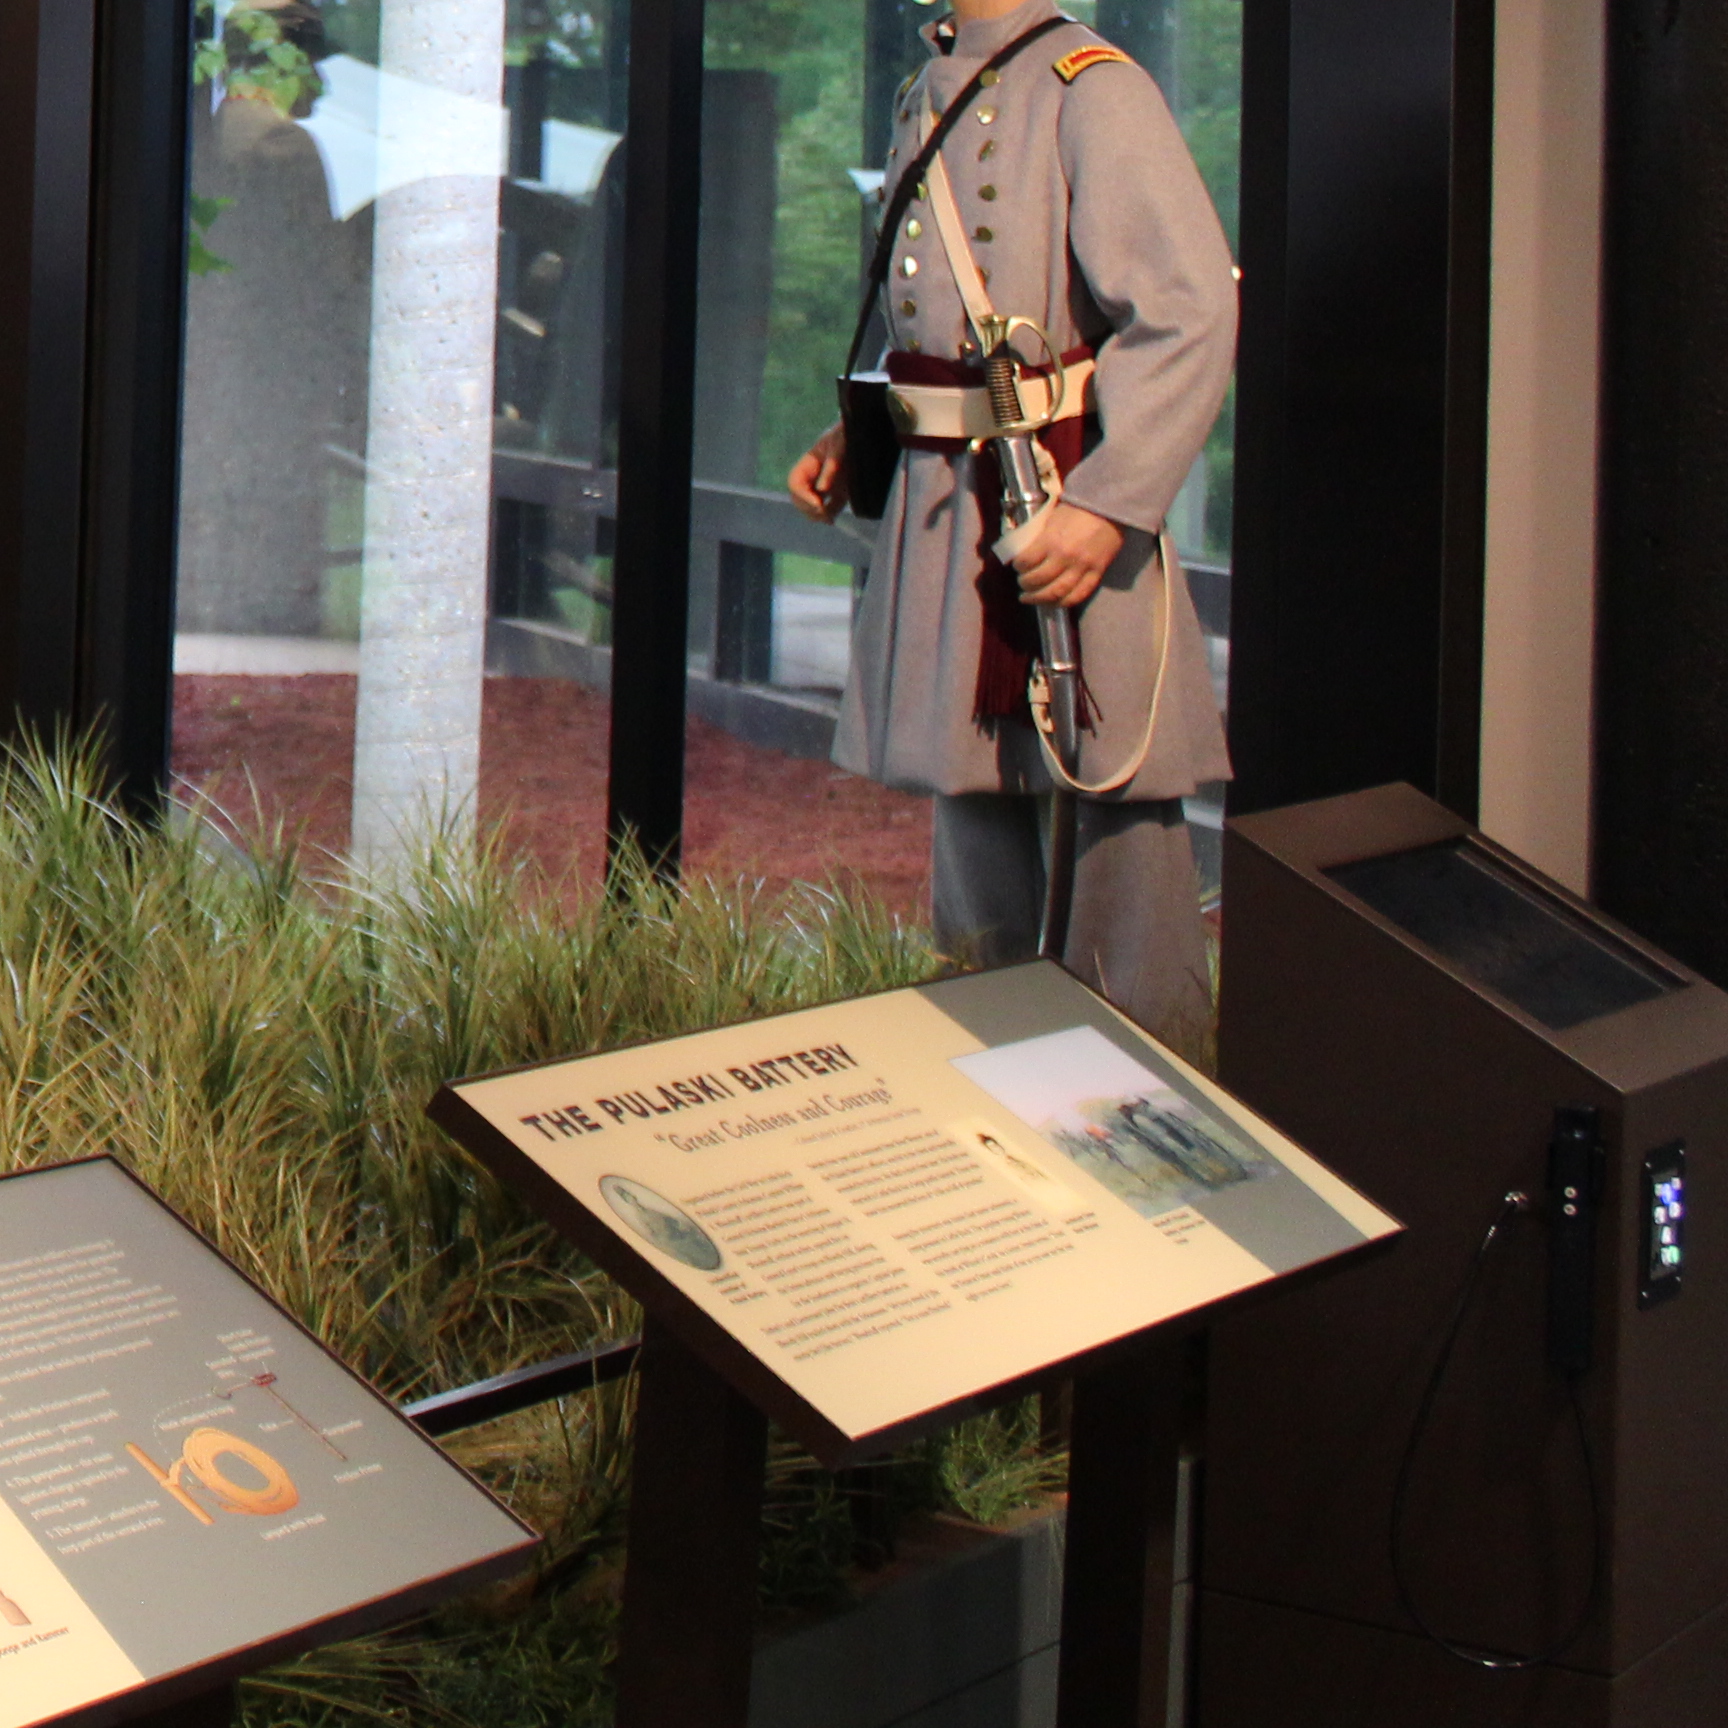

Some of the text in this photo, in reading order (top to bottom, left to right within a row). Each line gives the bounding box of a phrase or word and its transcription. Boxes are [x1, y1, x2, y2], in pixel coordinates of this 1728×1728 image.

[520, 1045, 856, 1141] THE PULASKI BATTERY
[653, 1129, 726, 1152] “Great
[719, 1112, 797, 1139] Coolness
[796, 1098, 830, 1121] and
[822, 1077, 892, 1112] Courage”
